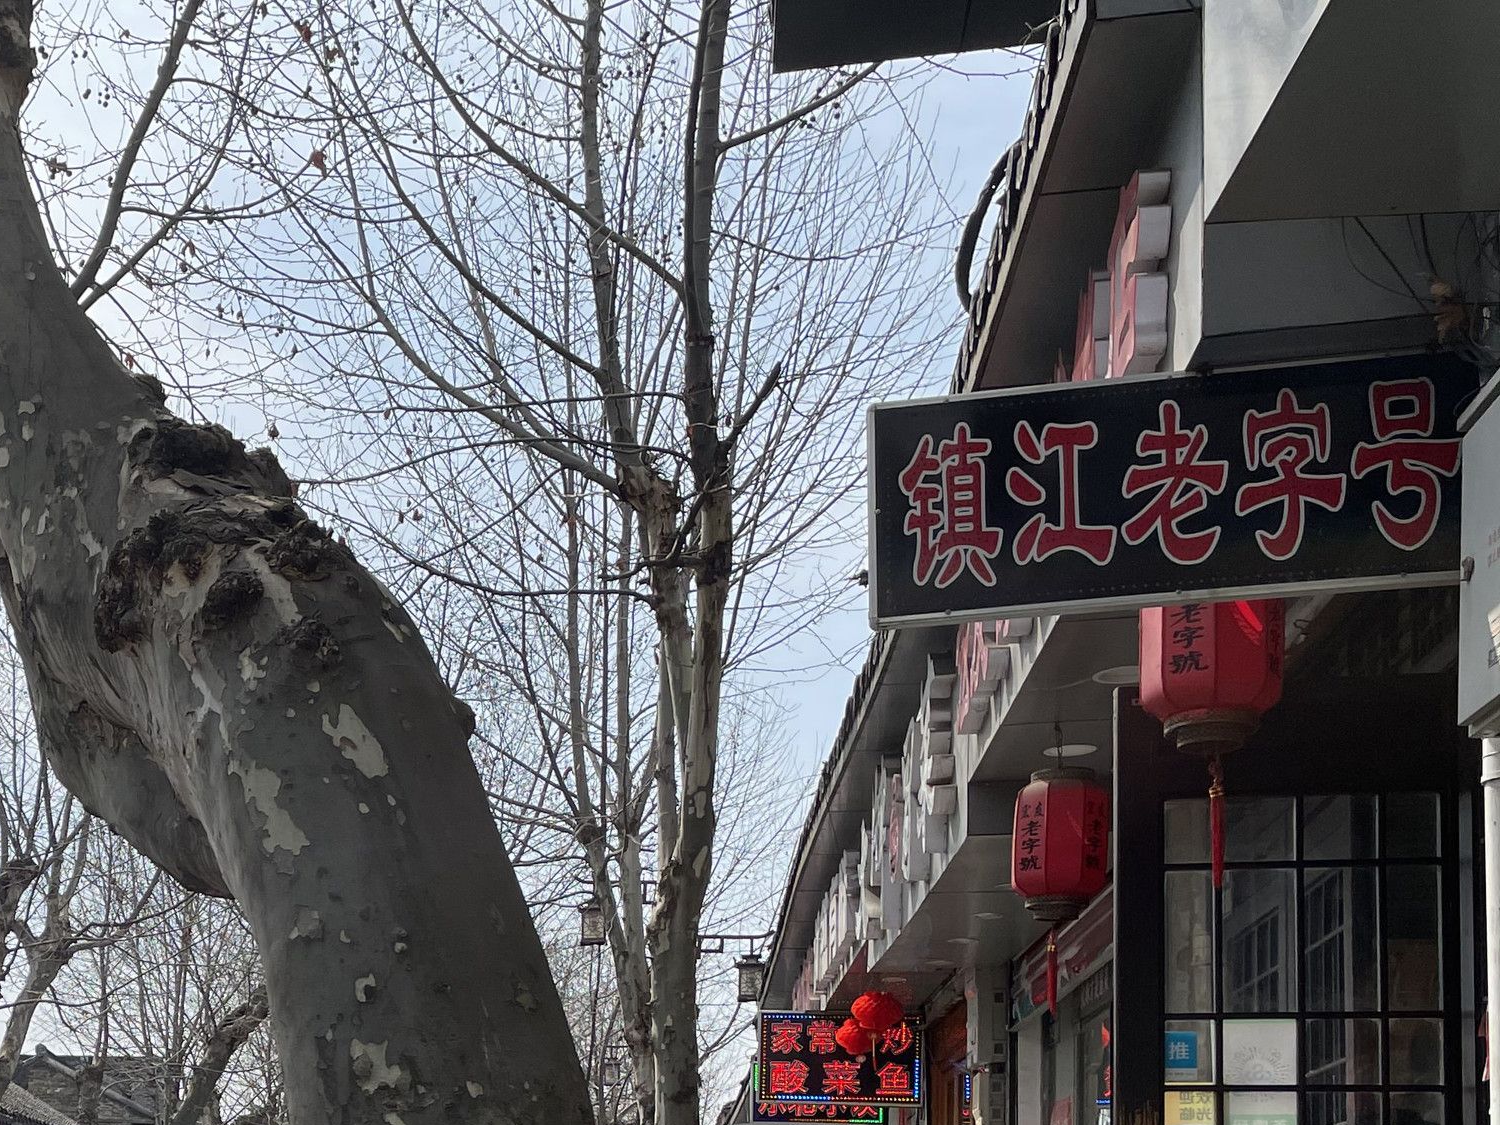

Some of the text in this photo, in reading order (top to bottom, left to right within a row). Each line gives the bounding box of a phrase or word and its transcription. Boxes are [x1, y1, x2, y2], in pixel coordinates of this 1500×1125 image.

[898, 377, 1462, 590] 镇江老字号
[1019, 820, 1042, 871] 老字號
[770, 1018, 914, 1056] 家常炒
[1168, 1041, 1190, 1061] 推
[769, 1059, 914, 1096] 酸菜鱼
